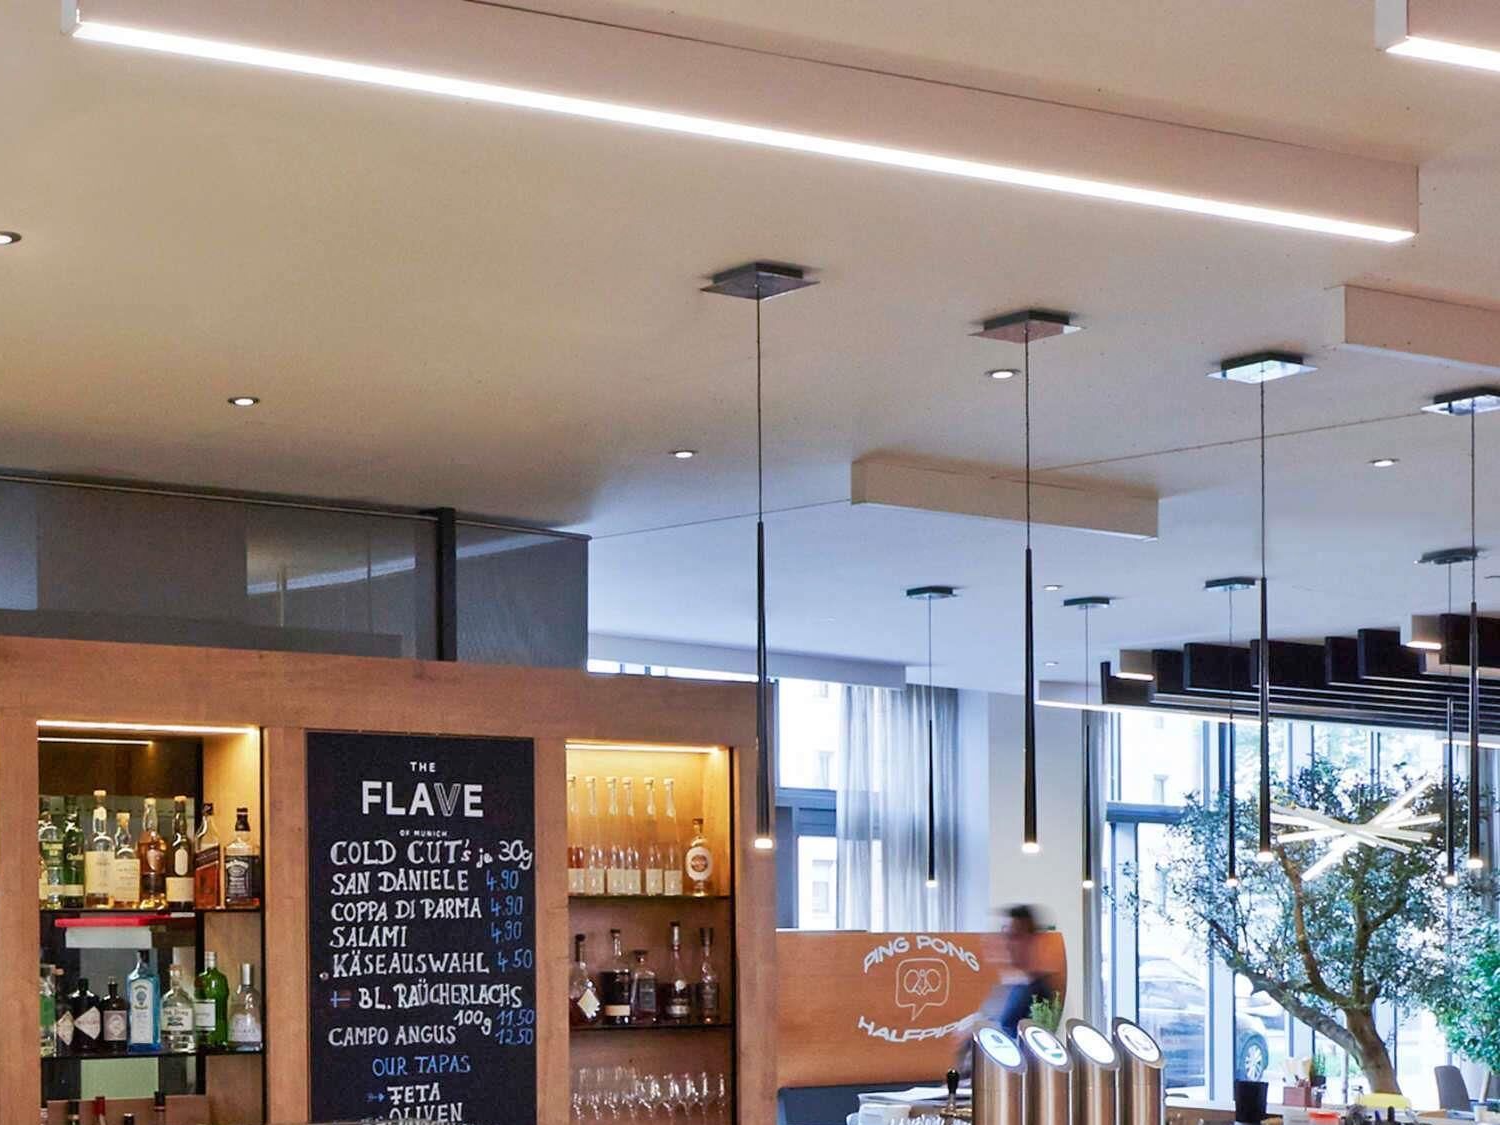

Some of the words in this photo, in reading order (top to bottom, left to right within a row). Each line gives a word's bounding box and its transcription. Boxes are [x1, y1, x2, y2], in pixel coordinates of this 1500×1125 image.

[410, 761, 436, 773] THE
[361, 780, 484, 818] FLAVE
[330, 840, 397, 866] COLD
[498, 839, 533, 871] 30g
[330, 871, 371, 896] SAN
[377, 867, 469, 893] DANIELE
[331, 899, 389, 924] COPPA
[394, 900, 416, 920] DI
[420, 897, 483, 920] PARMA
[330, 924, 408, 949] SALAMI
[332, 949, 490, 979] KÄSEAUSWAHL
[863, 936, 910, 974] PING
[916, 935, 980, 972] PONG
[358, 986, 392, 1010] BL.
[328, 1026, 389, 1047] CAMPO
[394, 1024, 456, 1046] ANGUS
[372, 1056, 408, 1077] OUR
[414, 1054, 471, 1075] TAPAS
[387, 1082, 441, 1106] FETA
